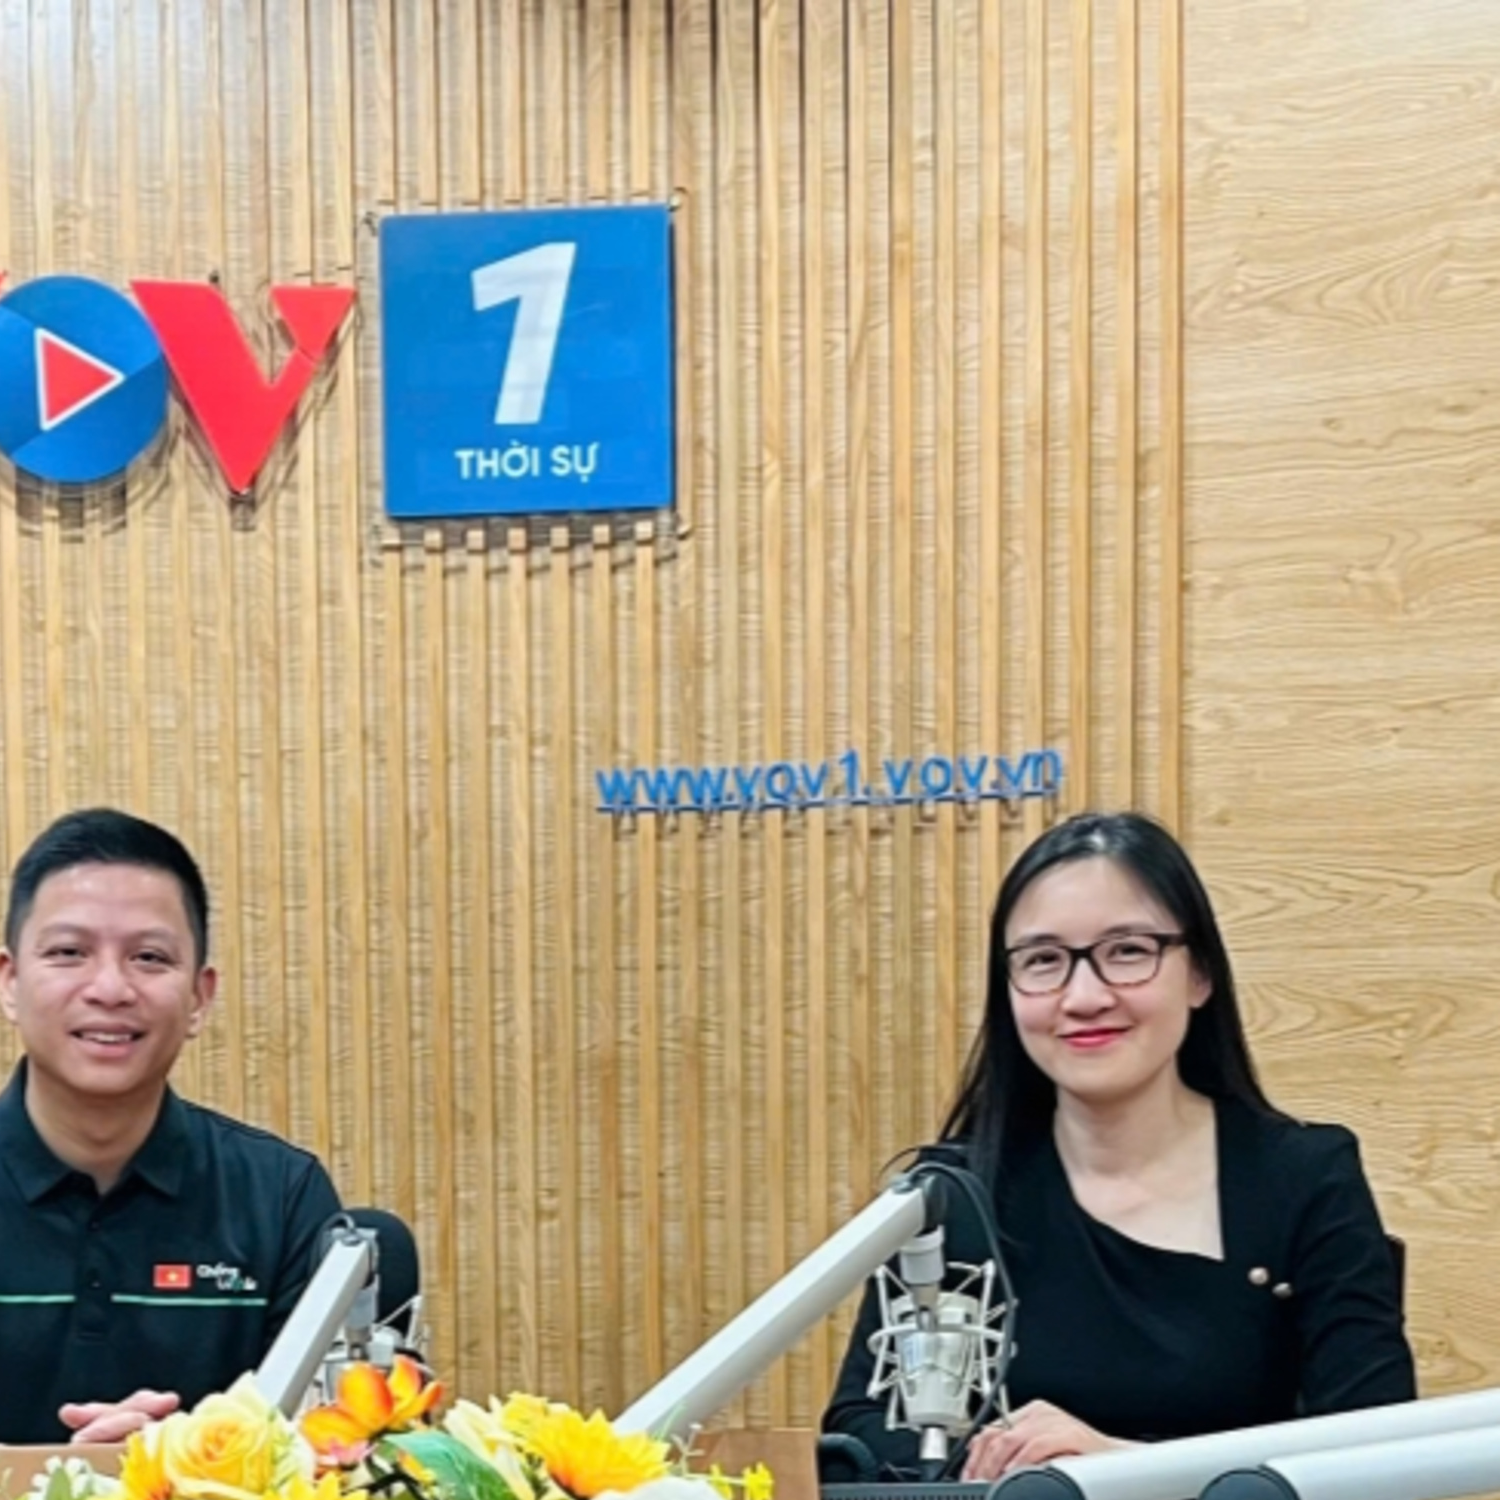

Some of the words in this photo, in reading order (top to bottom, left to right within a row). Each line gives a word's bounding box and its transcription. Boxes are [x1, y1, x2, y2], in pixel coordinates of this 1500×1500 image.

[471, 241, 577, 425] 1
[454, 438, 540, 479] THỜI
[551, 441, 599, 483] SỰ
[596, 748, 1062, 806] www.vov1.vov.vn
